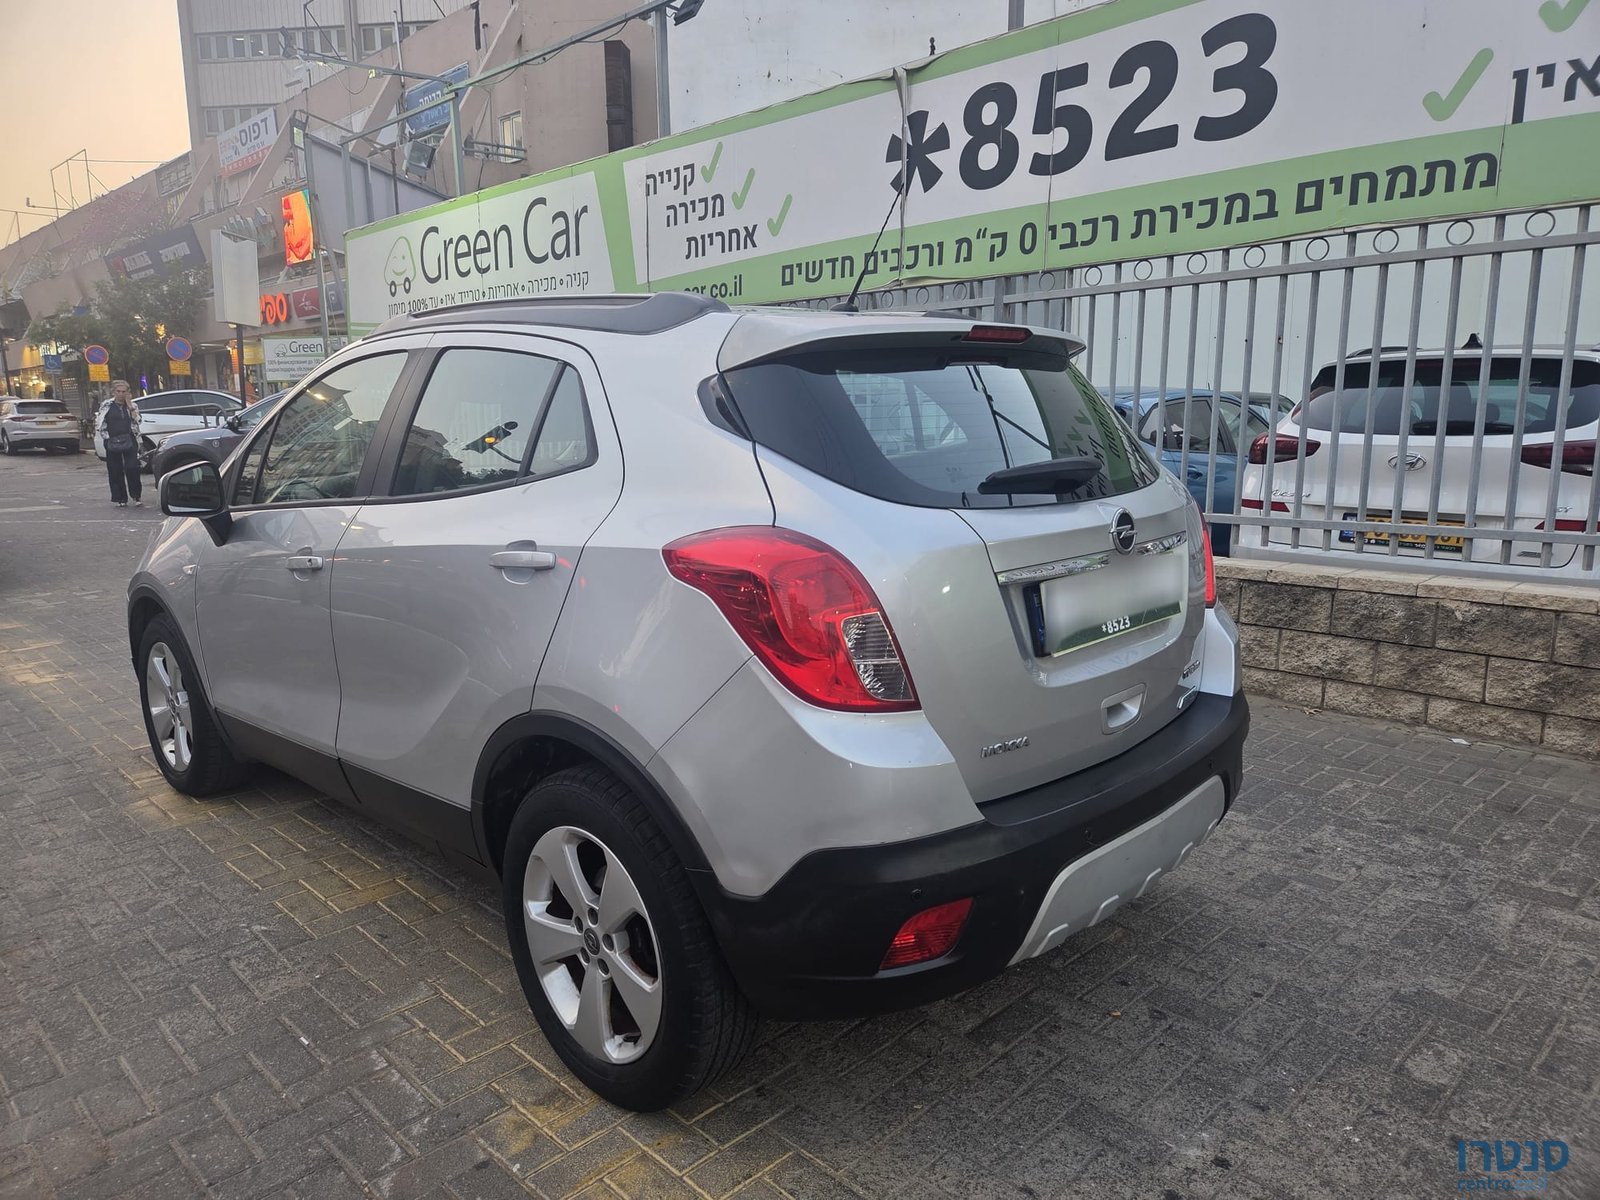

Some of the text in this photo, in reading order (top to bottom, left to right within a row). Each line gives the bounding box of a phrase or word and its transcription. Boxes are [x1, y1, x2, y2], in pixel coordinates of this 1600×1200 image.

[238, 116, 269, 147] דפוס
[645, 162, 696, 197] קנייה
[1295, 152, 1499, 215] מתמחים
[665, 193, 725, 228] מכירה
[1130, 188, 1279, 239] במכירת
[420, 196, 589, 285] Green Car
[685, 223, 759, 260] אחריות
[1018, 221, 1038, 255] 0
[1047, 214, 1120, 251] רכבי
[781, 255, 855, 287] חדשים
[863, 240, 945, 276] ורכבים
[486, 281, 520, 300] אחריות
[527, 276, 557, 295] מכירה
[565, 270, 590, 291] קניה
[387, 301, 406, 320] מימון
[407, 297, 429, 313] 100%
[289, 341, 323, 353] Green
